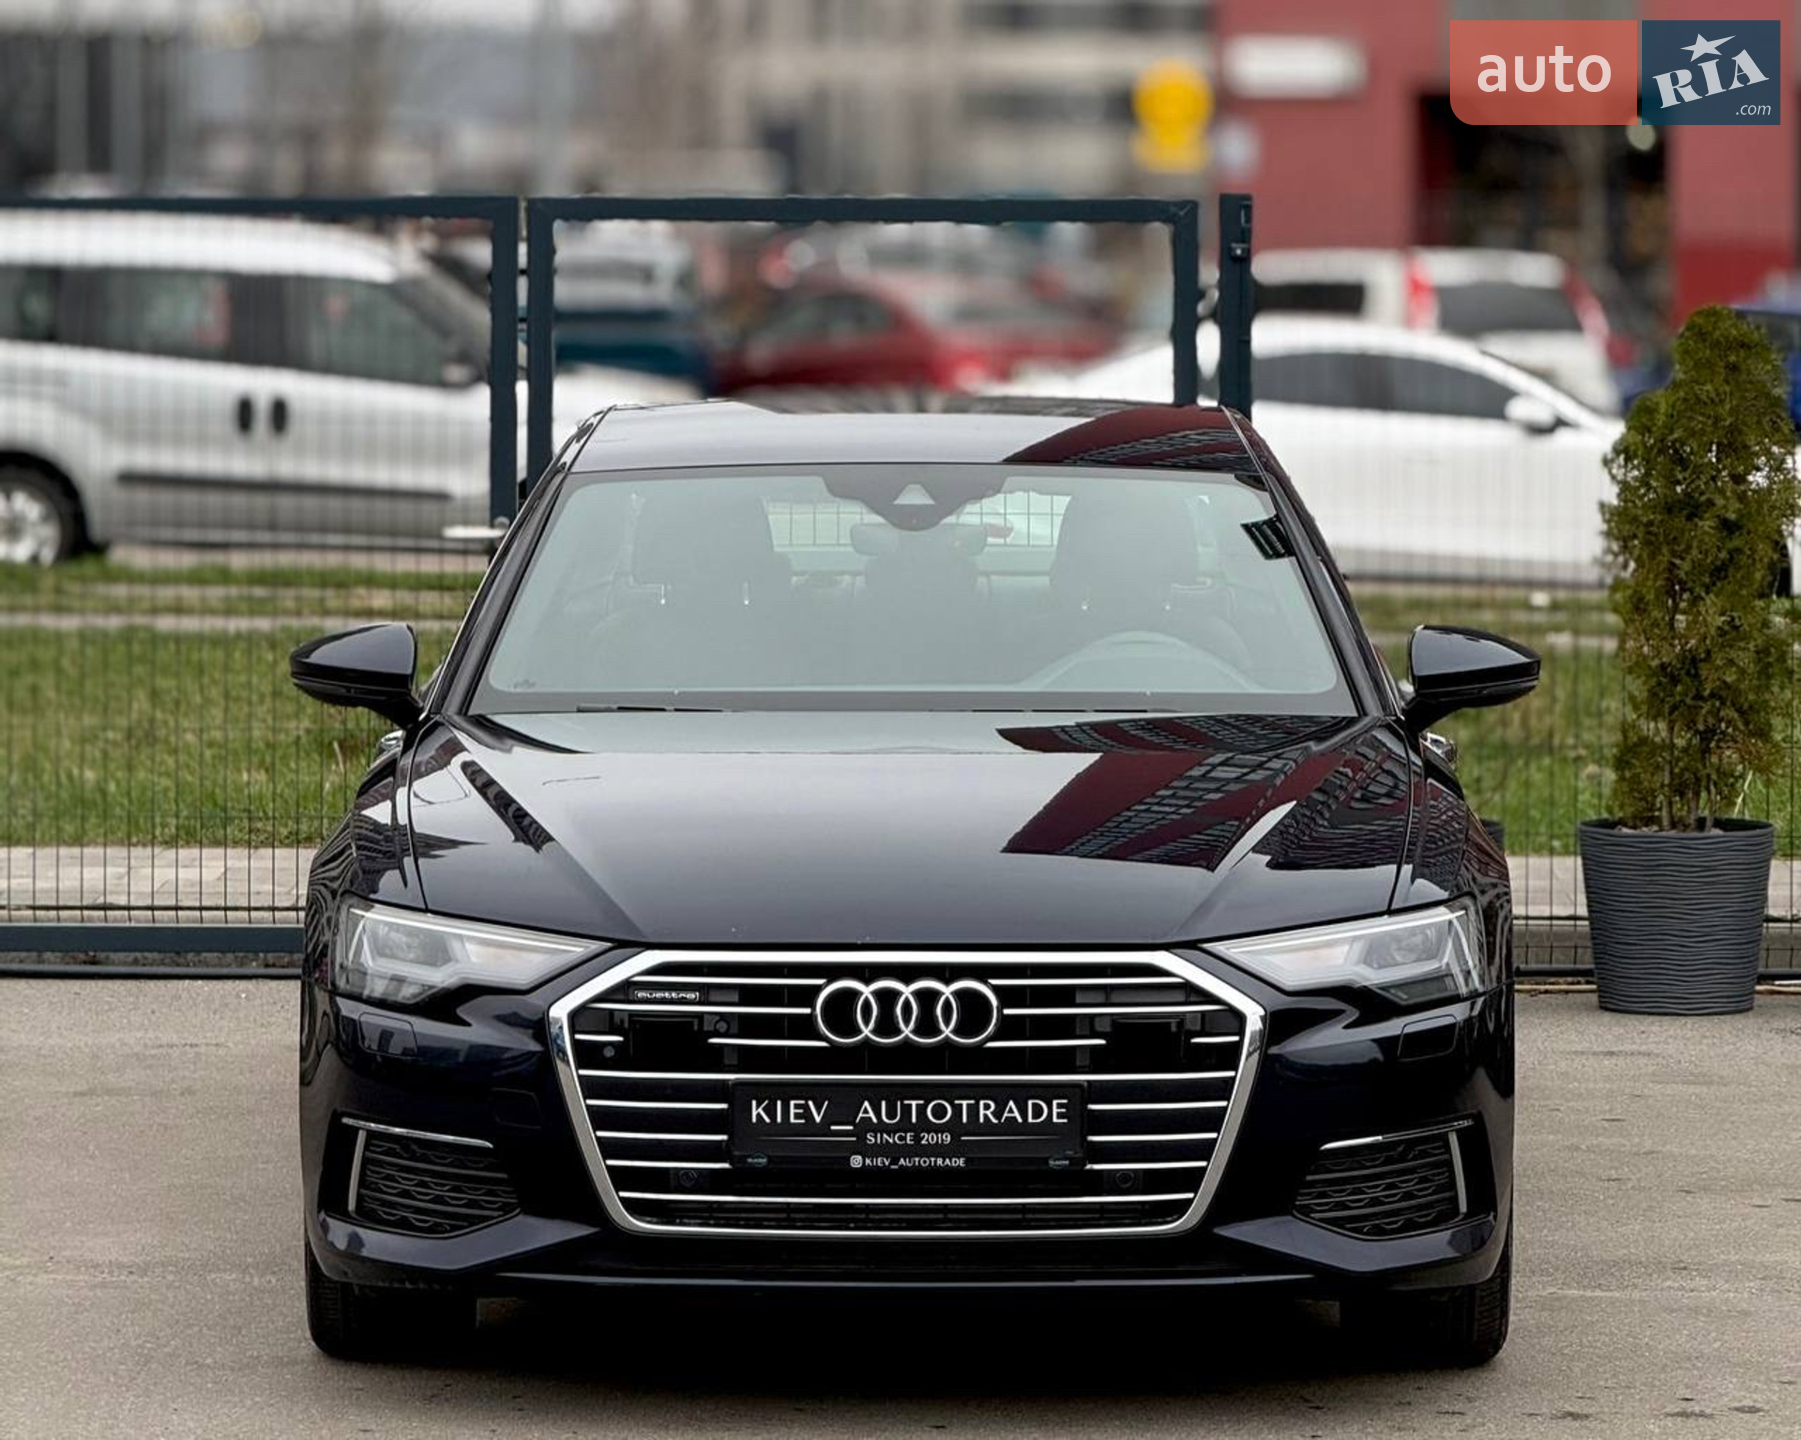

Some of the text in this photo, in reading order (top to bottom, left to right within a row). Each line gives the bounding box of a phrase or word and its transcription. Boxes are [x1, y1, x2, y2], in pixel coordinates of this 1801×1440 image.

[751, 1100, 1068, 1130] KIEV_AUTOTRADE
[866, 1132, 951, 1145] SINCE 2019
[864, 1157, 966, 1169] KIEV_AUTOTRADE
